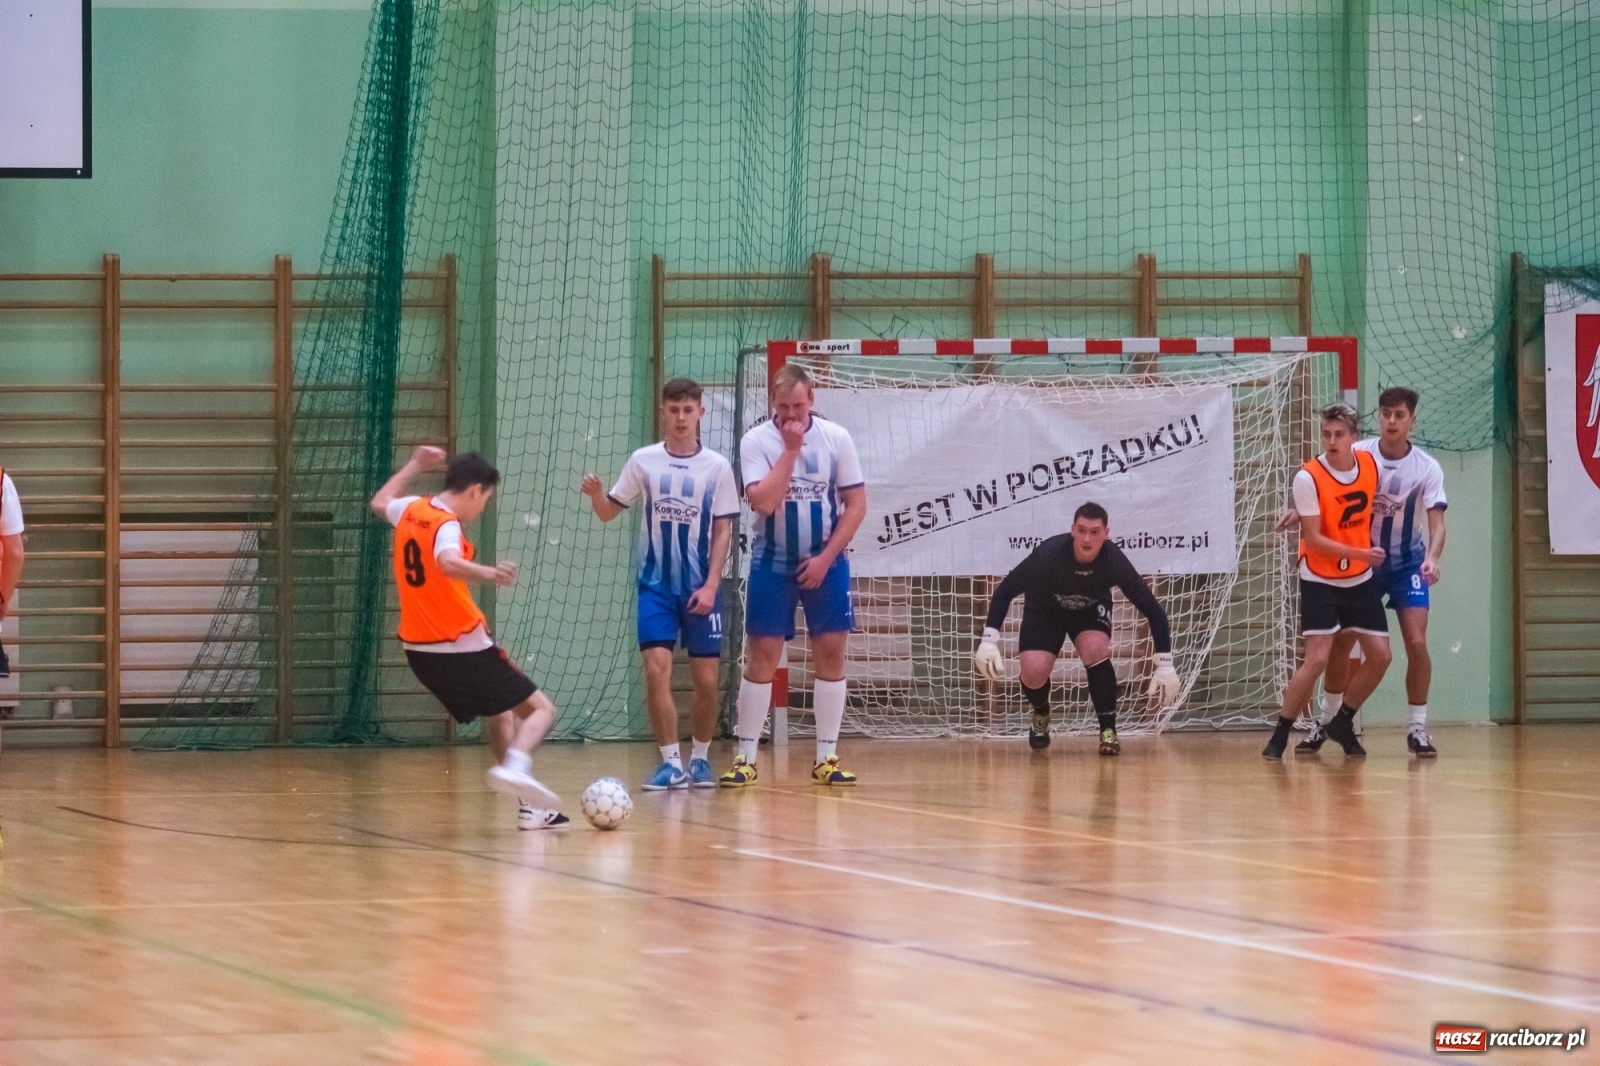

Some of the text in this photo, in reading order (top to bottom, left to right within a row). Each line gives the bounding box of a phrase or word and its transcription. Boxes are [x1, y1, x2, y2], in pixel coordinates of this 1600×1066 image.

[826, 343, 850, 353] sport
[877, 414, 1205, 543] JEST W PORZĄDKU!
[403, 538, 426, 588] 9
[1411, 574, 1421, 590] 8
[708, 612, 722, 632] 11
